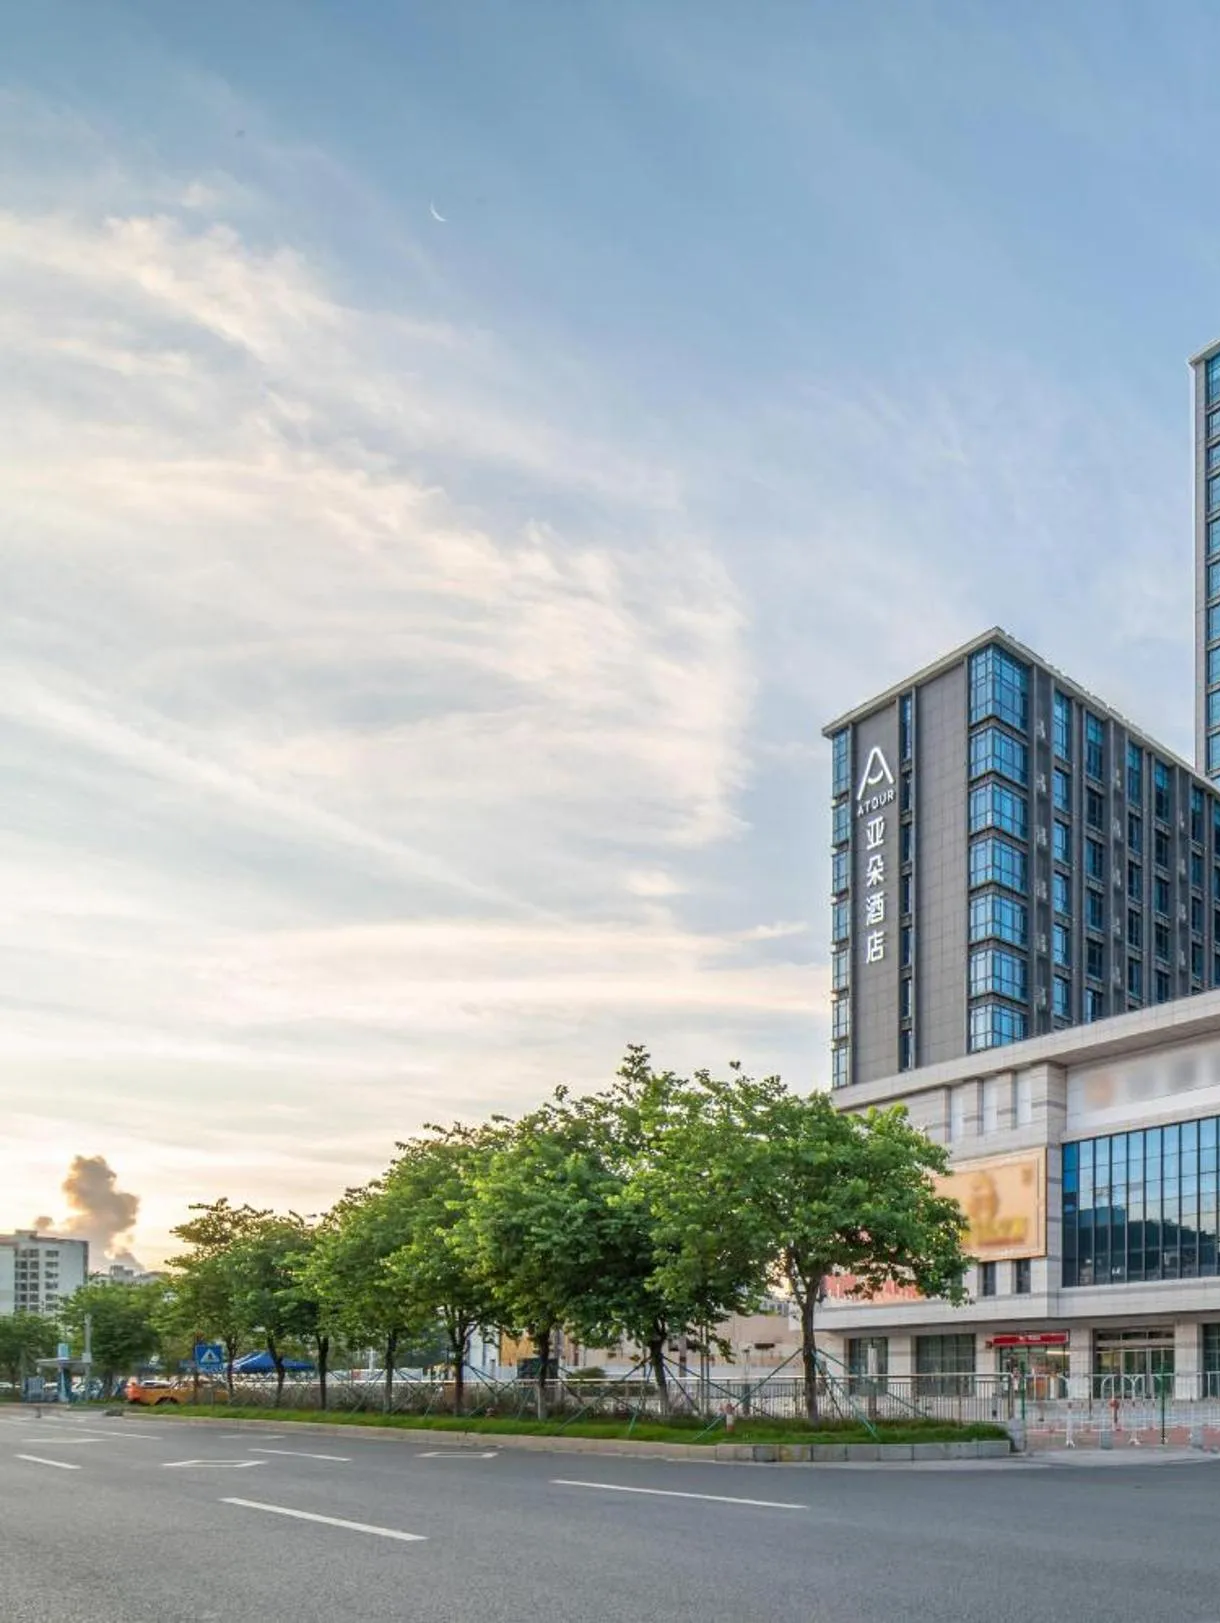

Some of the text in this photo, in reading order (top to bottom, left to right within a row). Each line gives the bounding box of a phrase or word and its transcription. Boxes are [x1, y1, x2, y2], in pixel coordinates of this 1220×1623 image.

[857, 788, 894, 817] ATOUR
[866, 816, 885, 964] 亚朵酒店
